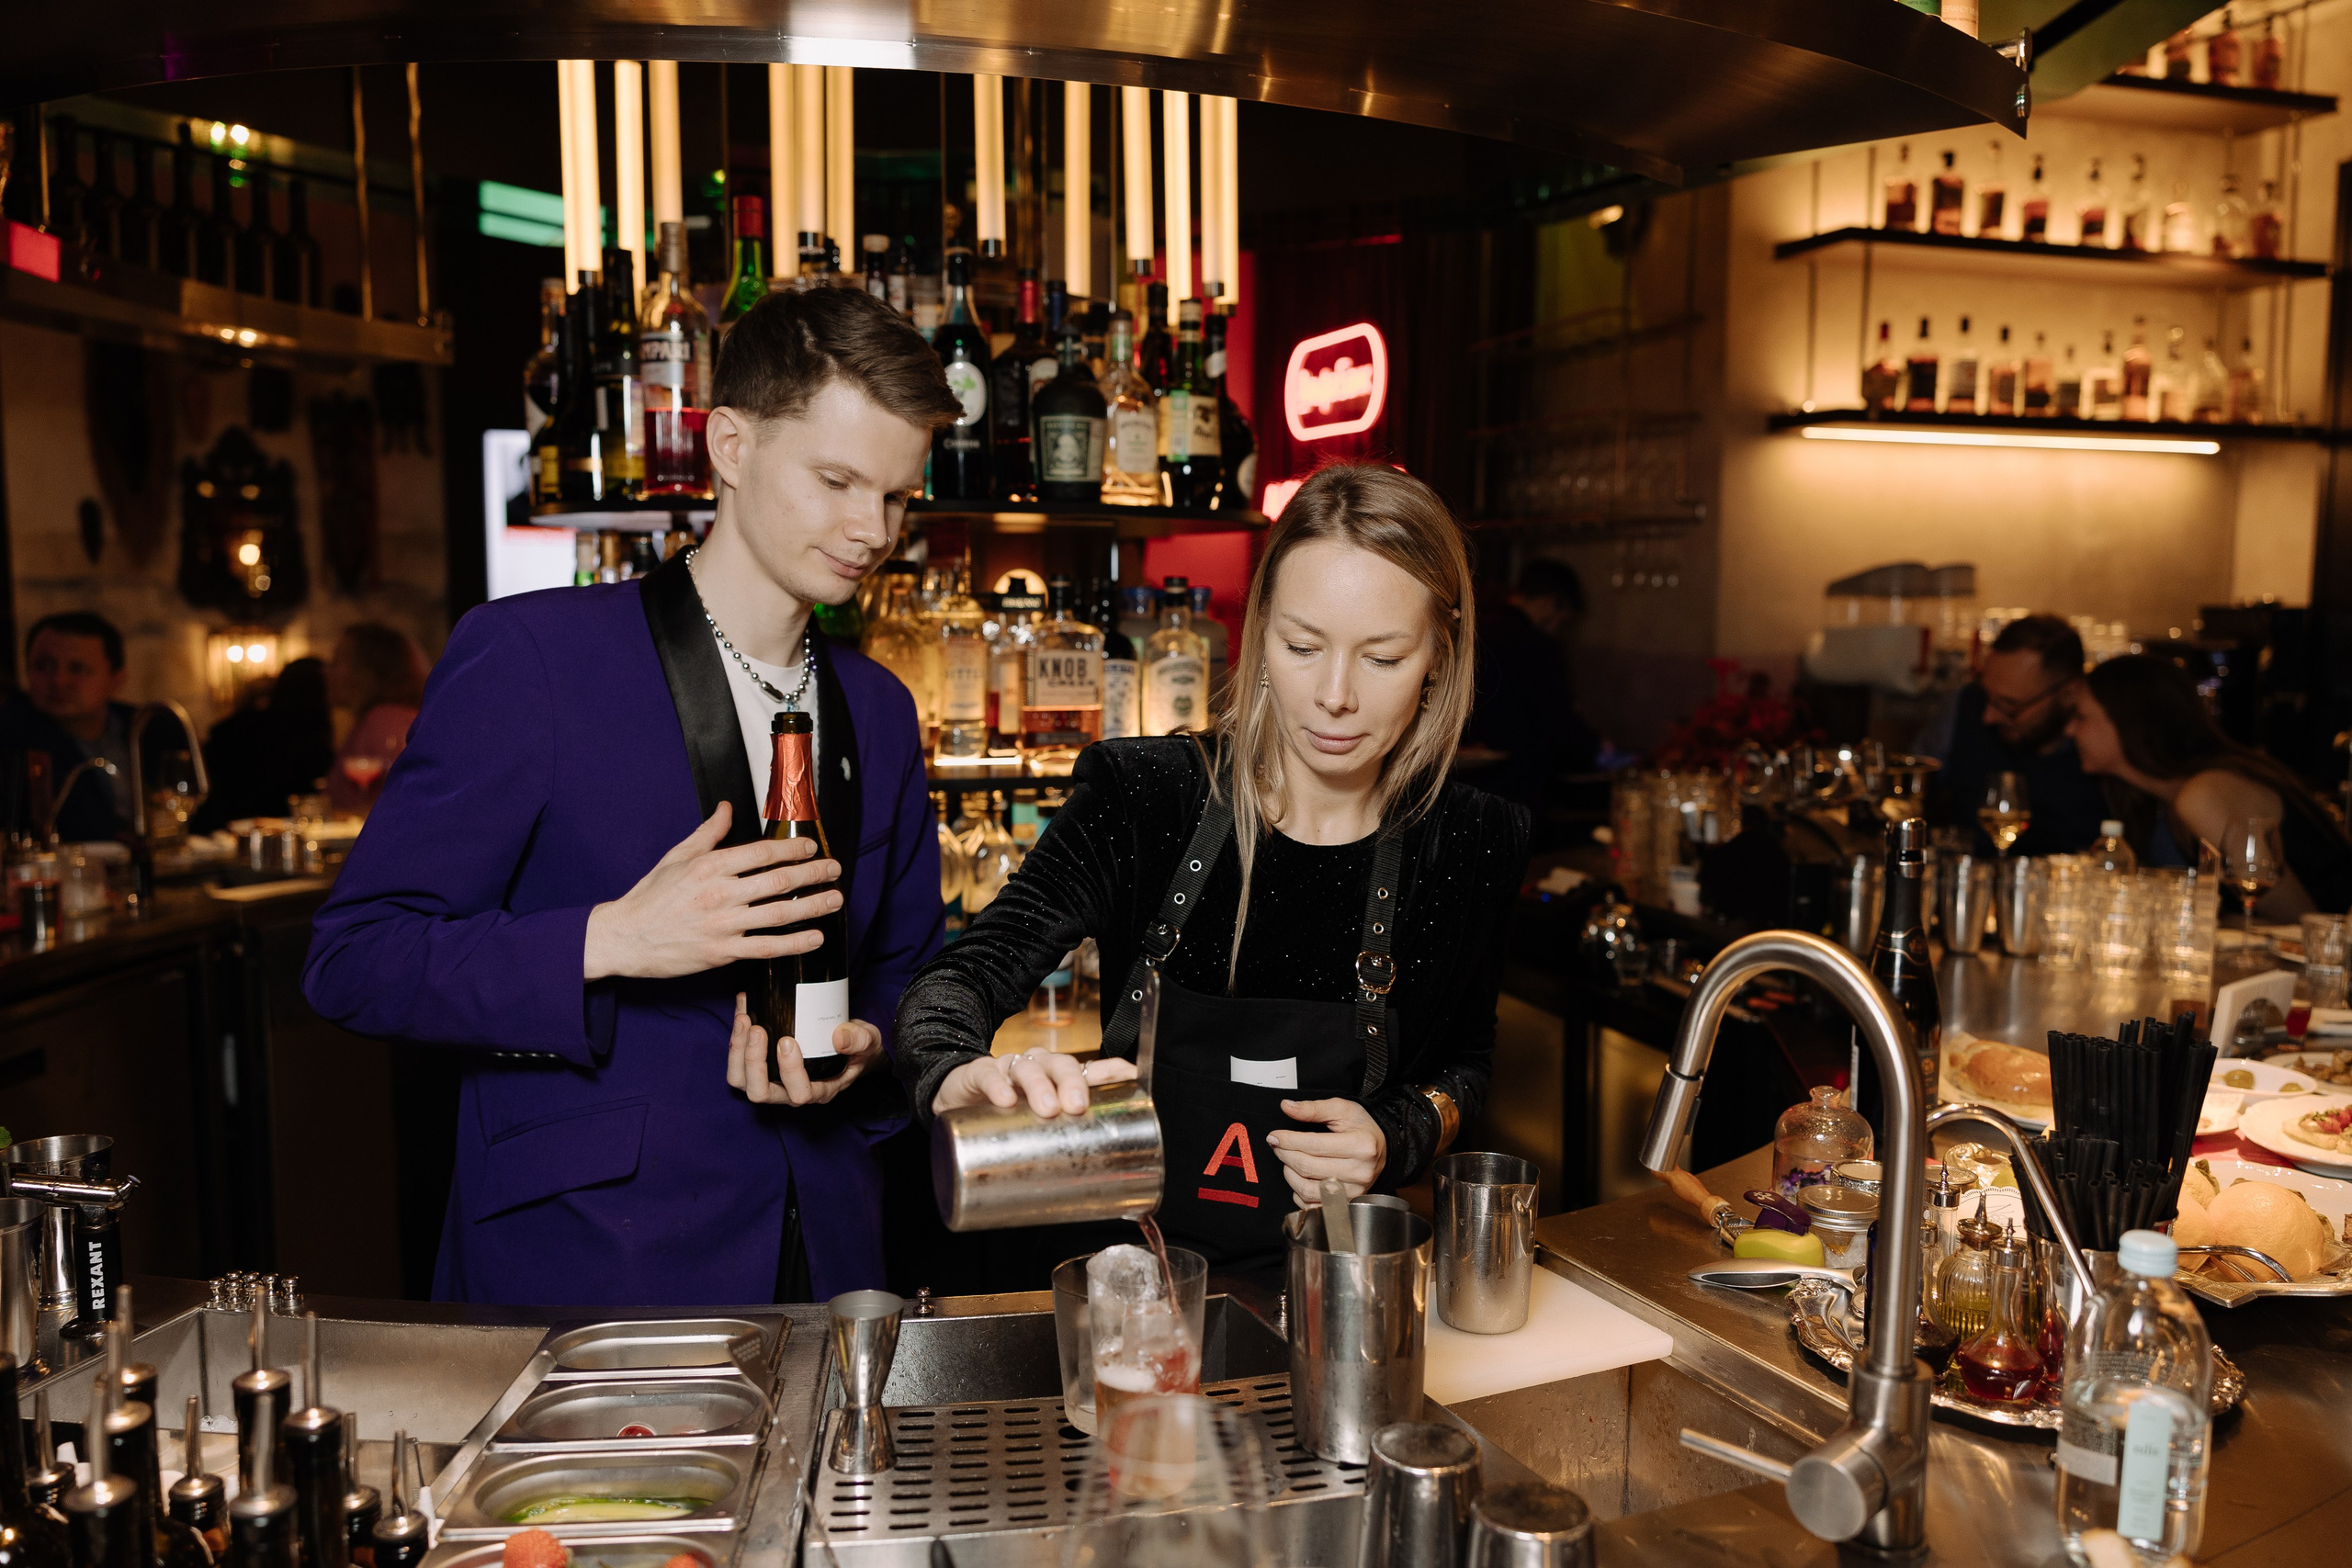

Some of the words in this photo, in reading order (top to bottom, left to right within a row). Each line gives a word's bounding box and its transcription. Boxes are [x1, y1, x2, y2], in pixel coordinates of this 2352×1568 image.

[1943, 5, 1969, 14] BRANDY
[1039, 657, 1087, 679] KNOB
[1203, 1122, 1260, 1184] A
[88, 1241, 106, 1310] REXANT
